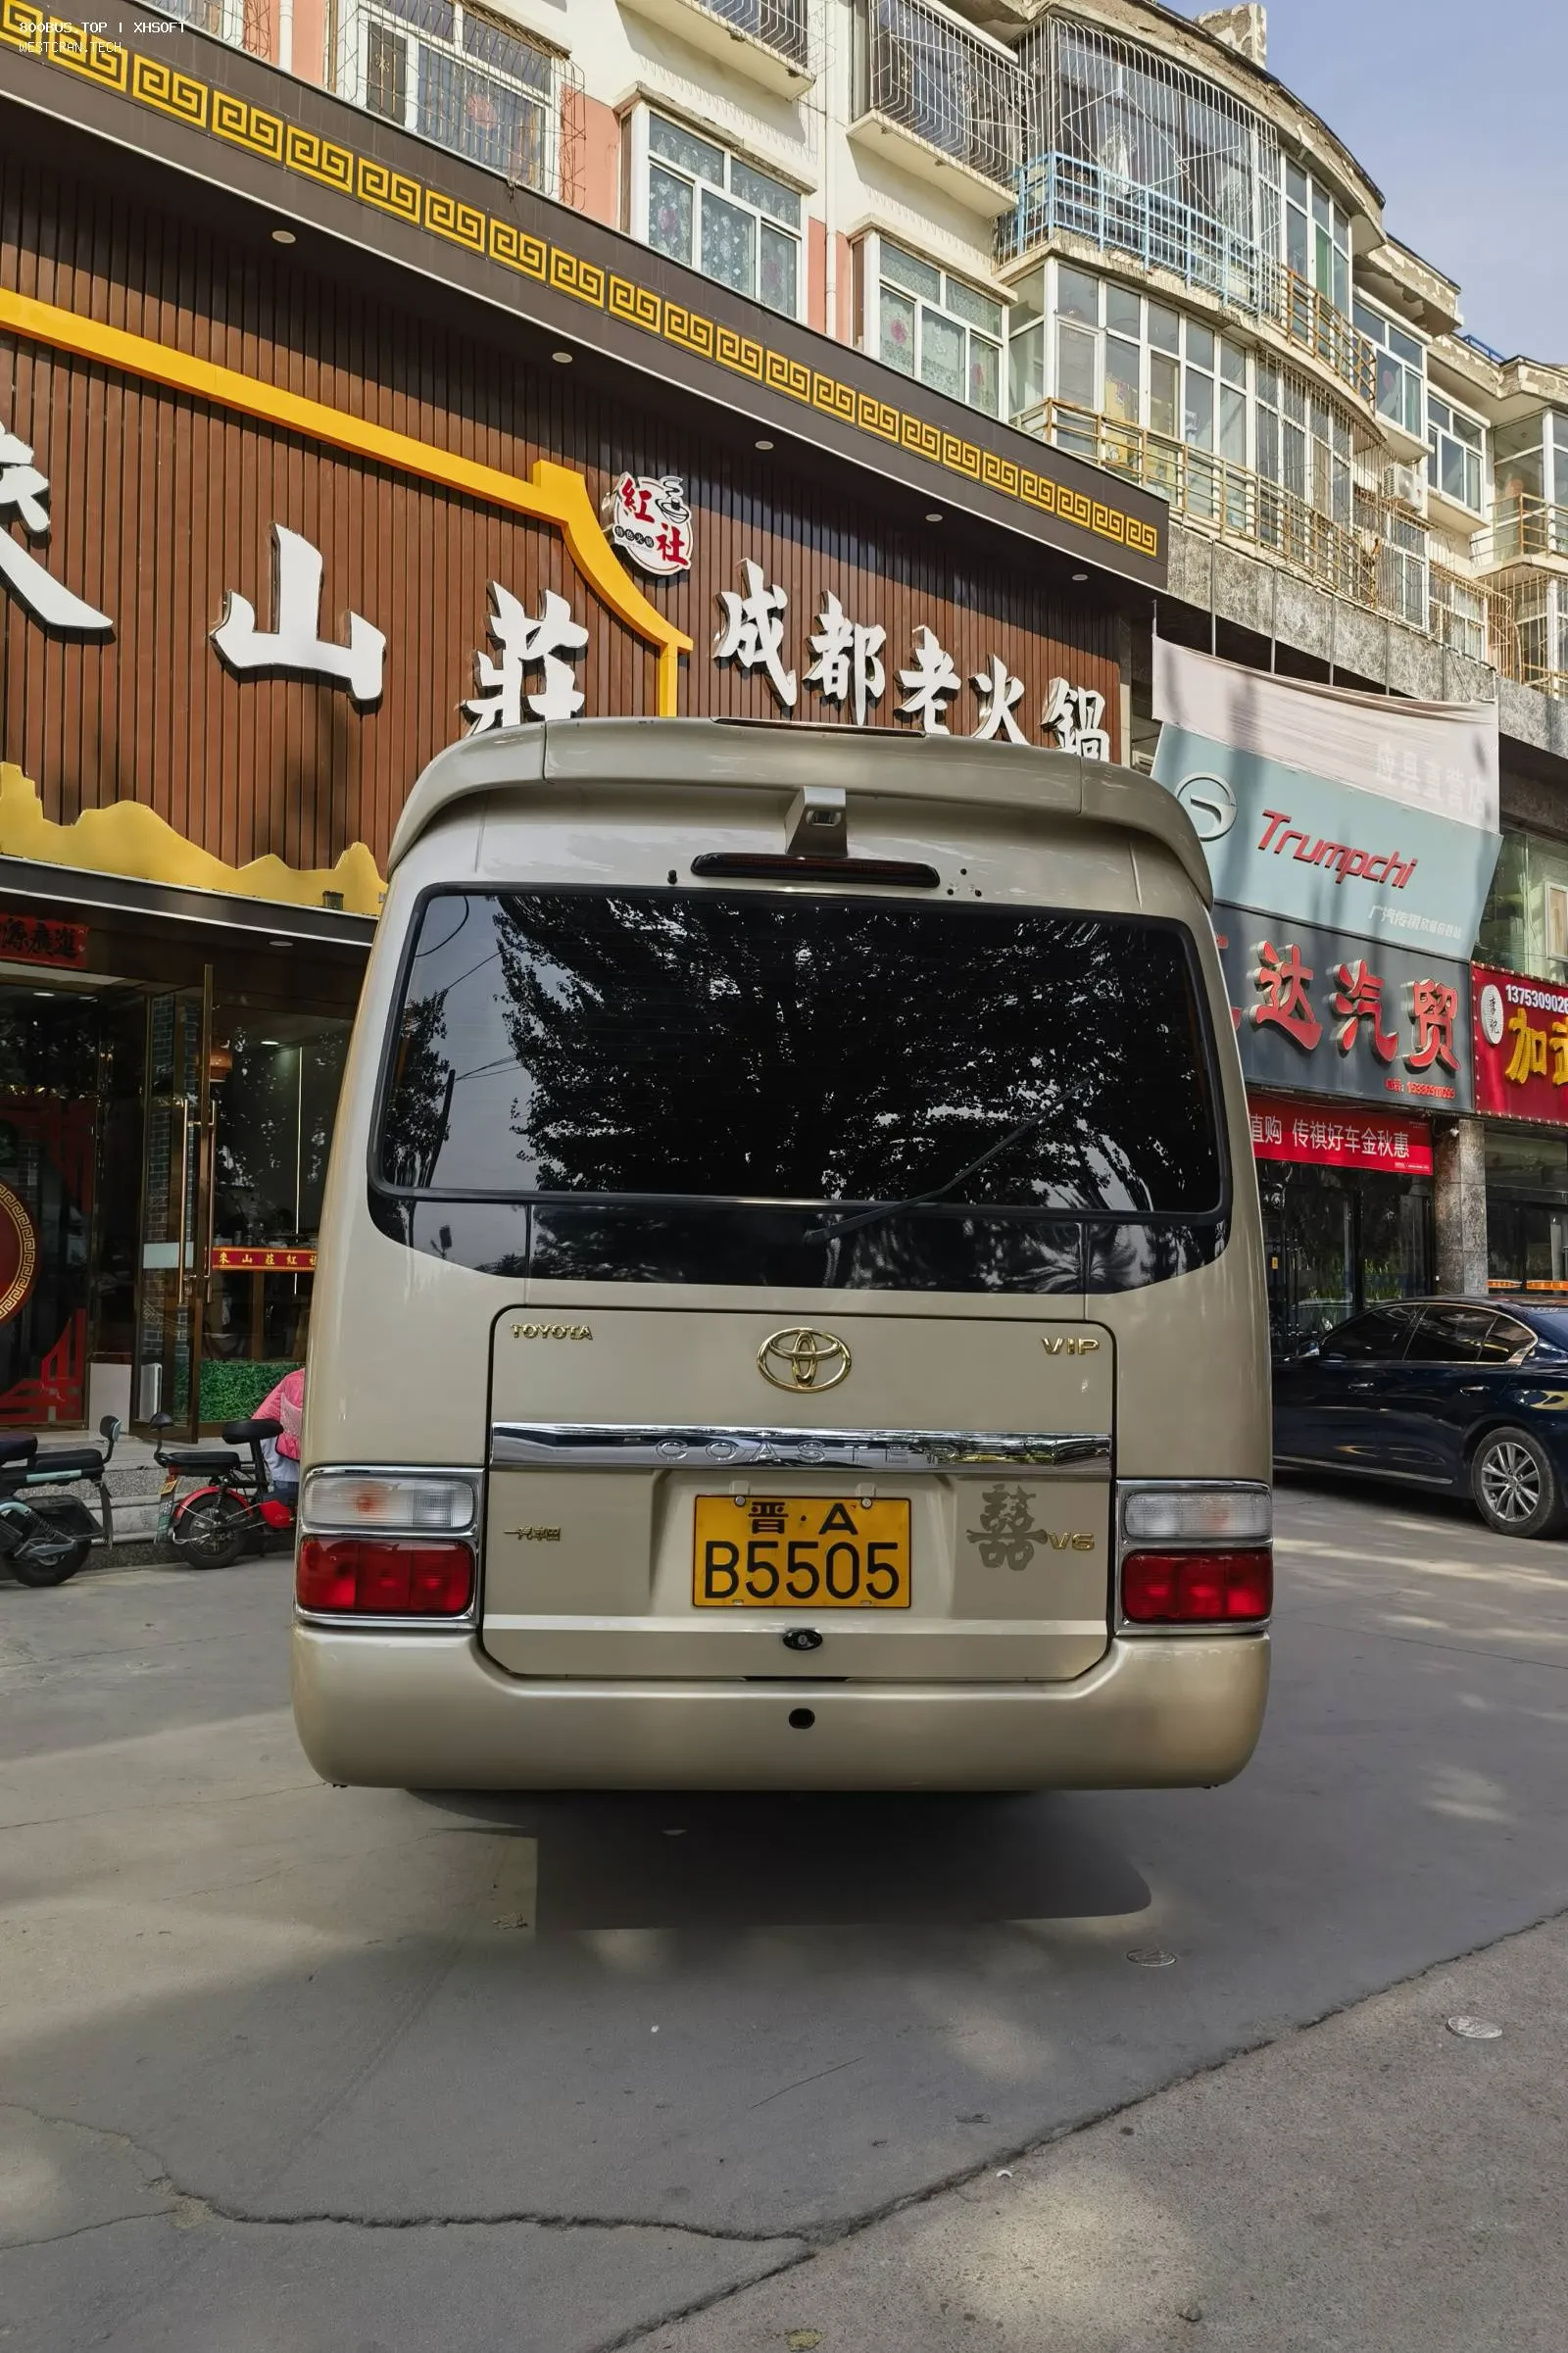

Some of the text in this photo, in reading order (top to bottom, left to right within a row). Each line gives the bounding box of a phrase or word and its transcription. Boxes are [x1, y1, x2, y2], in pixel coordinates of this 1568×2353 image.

[0, 420, 589, 736] 山莊
[1257, 809, 1418, 889] Trumpchi
[1216, 933, 1460, 1072] 达汽贸
[1293, 1118, 1410, 1158] 传祺好车金秋惠
[511, 1324, 593, 1341] TOYOTA
[1042, 1337, 1100, 1355] VIP
[656, 1438, 961, 1466] COASTER
[1048, 1532, 1096, 1550] V6
[705, 1541, 900, 1600] B5505
